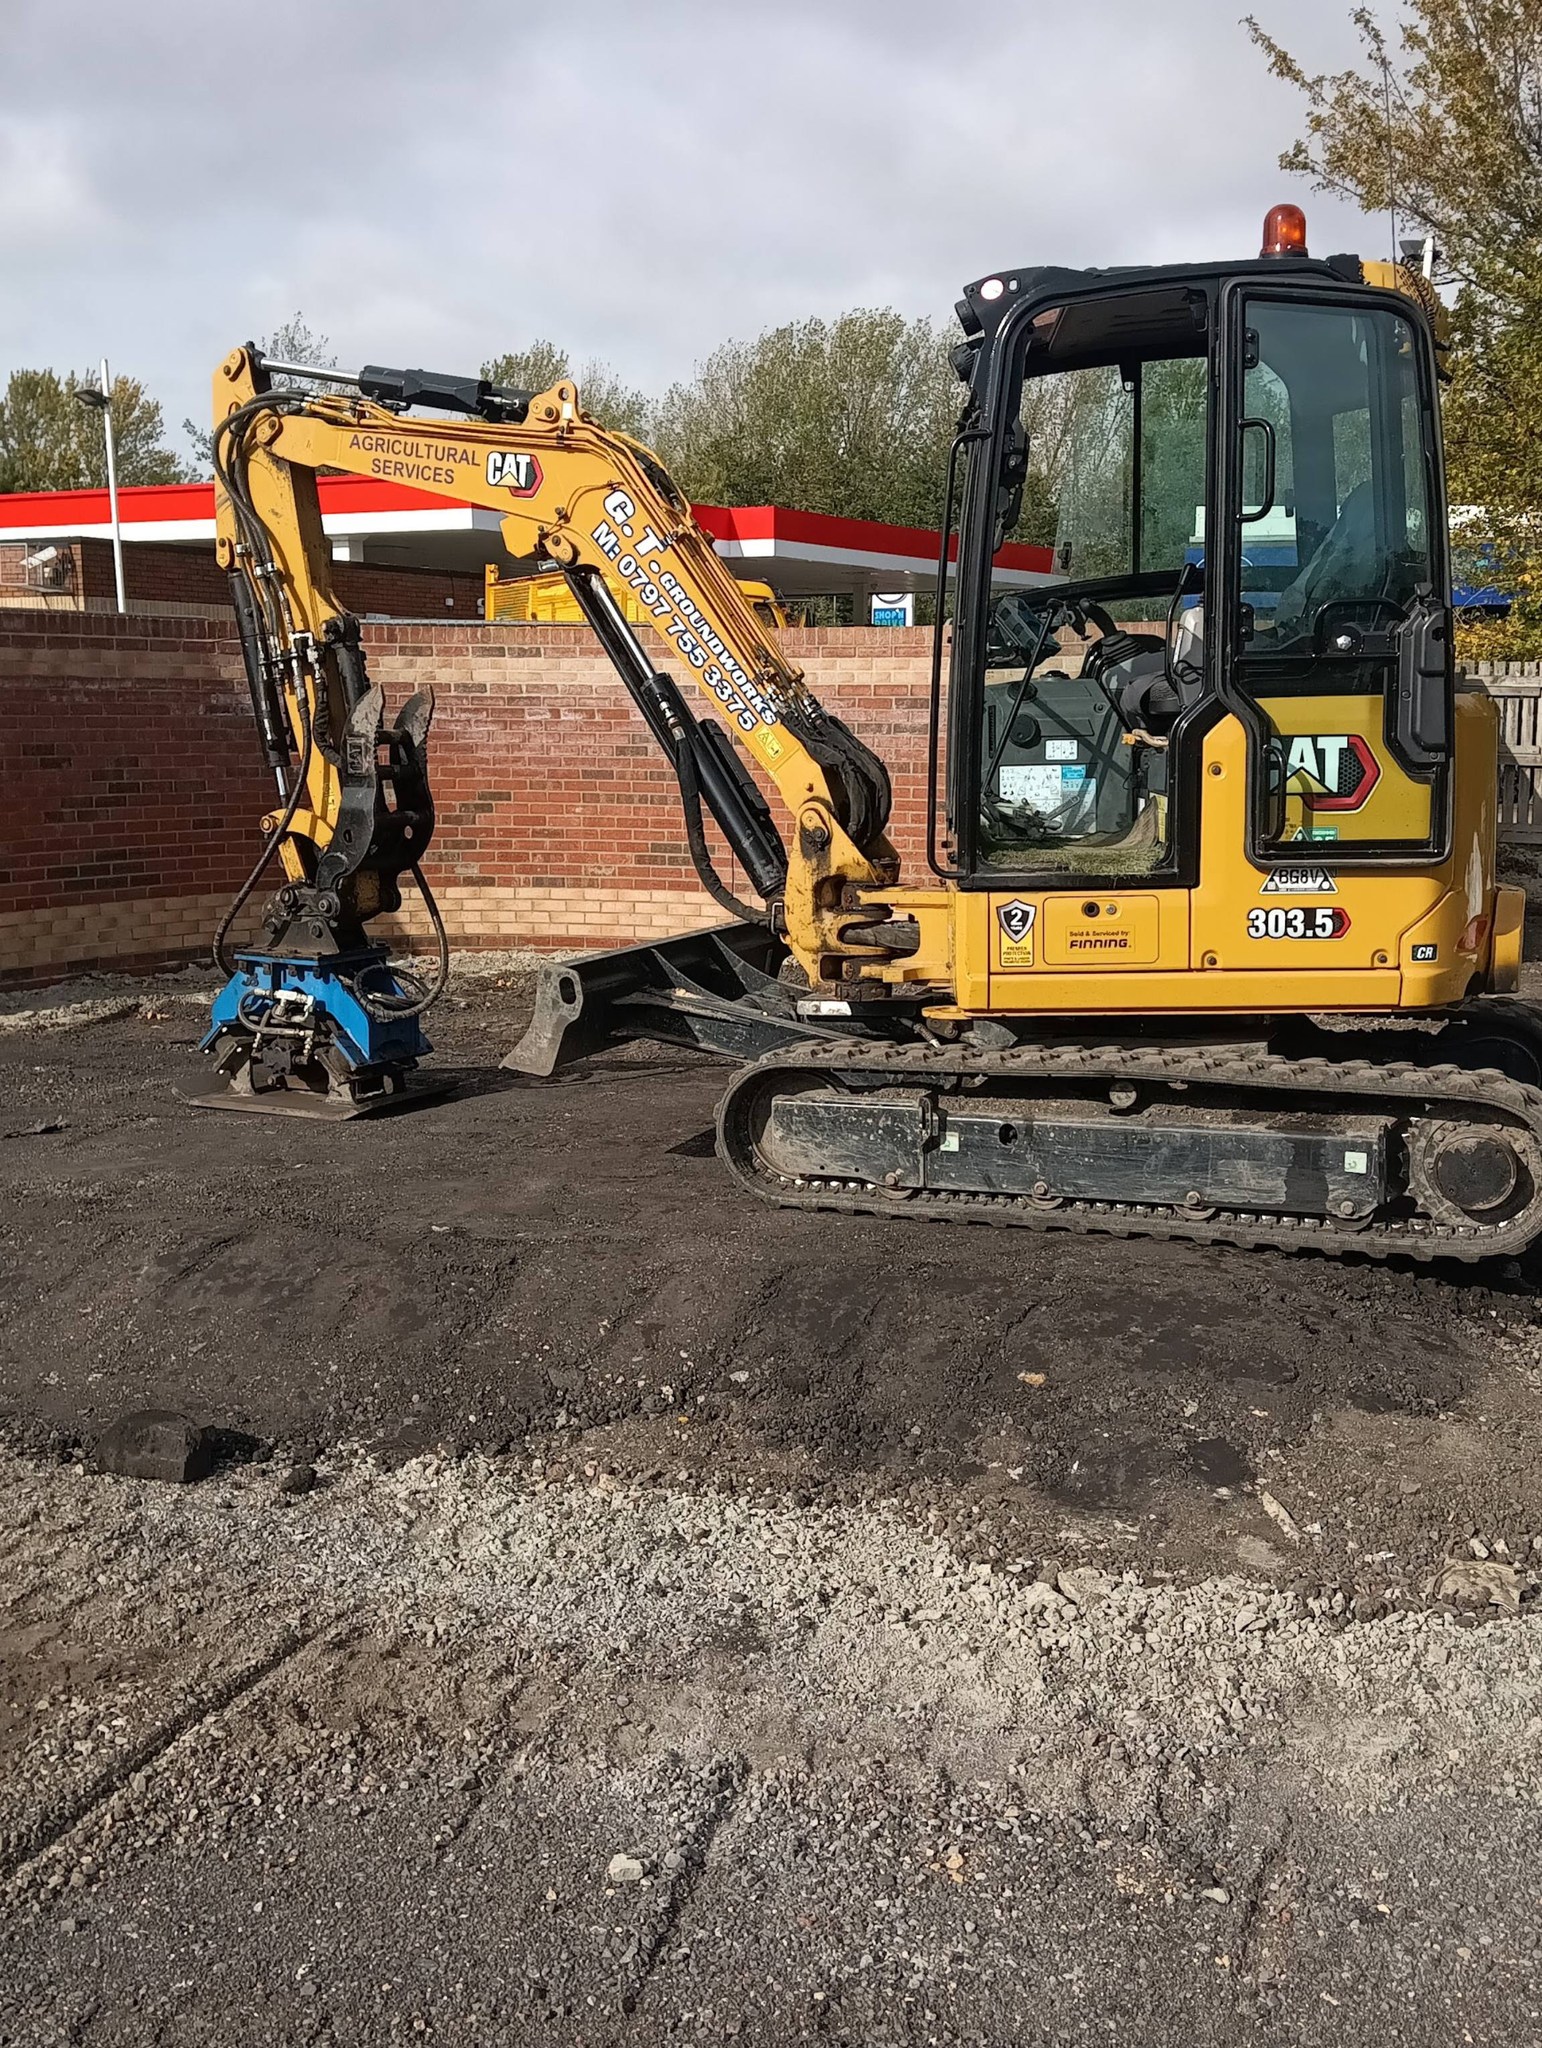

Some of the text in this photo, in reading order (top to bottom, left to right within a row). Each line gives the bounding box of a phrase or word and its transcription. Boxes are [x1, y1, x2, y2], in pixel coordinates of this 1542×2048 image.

[349, 434, 481, 466] AGRICULTURAL
[371, 458, 455, 484] SERVICES
[487, 451, 531, 488] CAT
[617, 553, 674, 618] 0797
[665, 616, 711, 668] 755
[702, 664, 758, 731] 3375
[658, 570, 777, 725] GROUNDWORKS
[1010, 909, 1023, 926] 2
[1247, 908, 1334, 938] 303.5
[1416, 947, 1434, 959] CR
